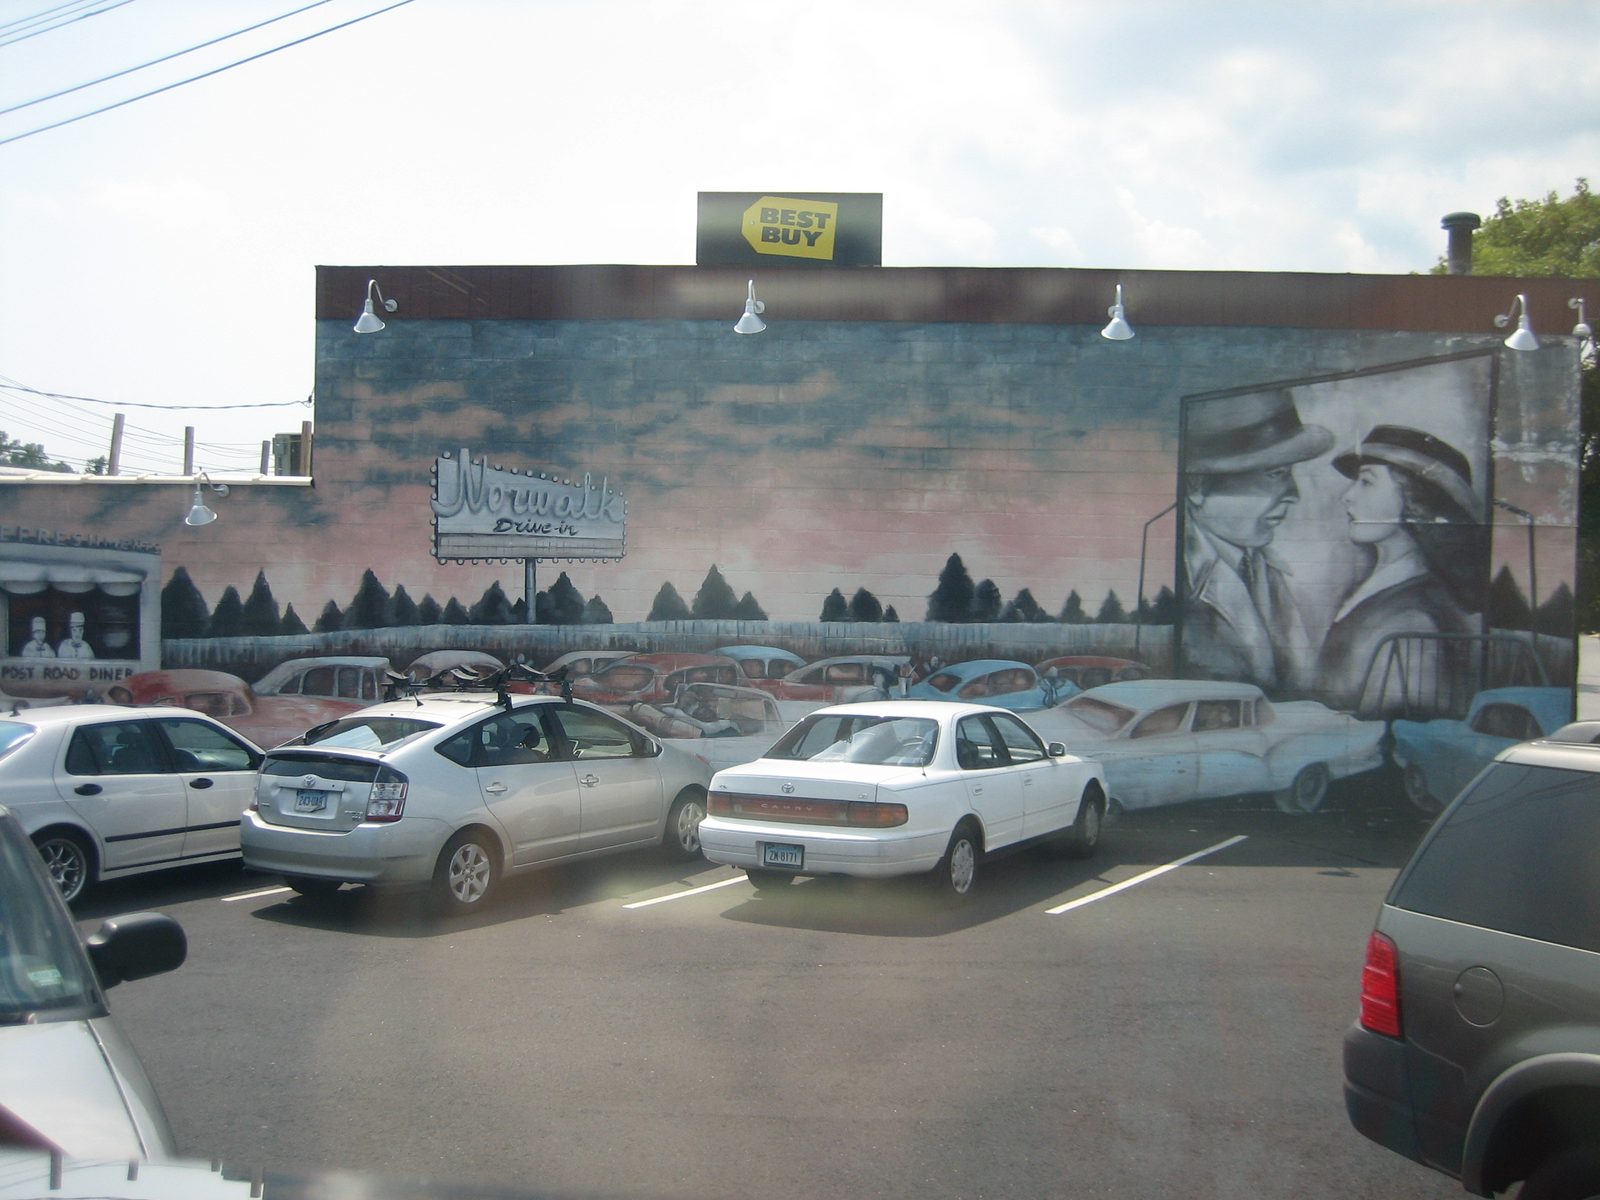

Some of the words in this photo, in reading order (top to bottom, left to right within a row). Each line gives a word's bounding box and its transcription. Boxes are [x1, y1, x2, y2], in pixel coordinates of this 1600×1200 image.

[759, 207, 832, 229] BEST
[761, 226, 823, 247] BUY
[431, 448, 624, 523] Norwalk
[1, 665, 35, 680] POST
[43, 666, 80, 681] ROAD
[89, 667, 134, 681] DINER
